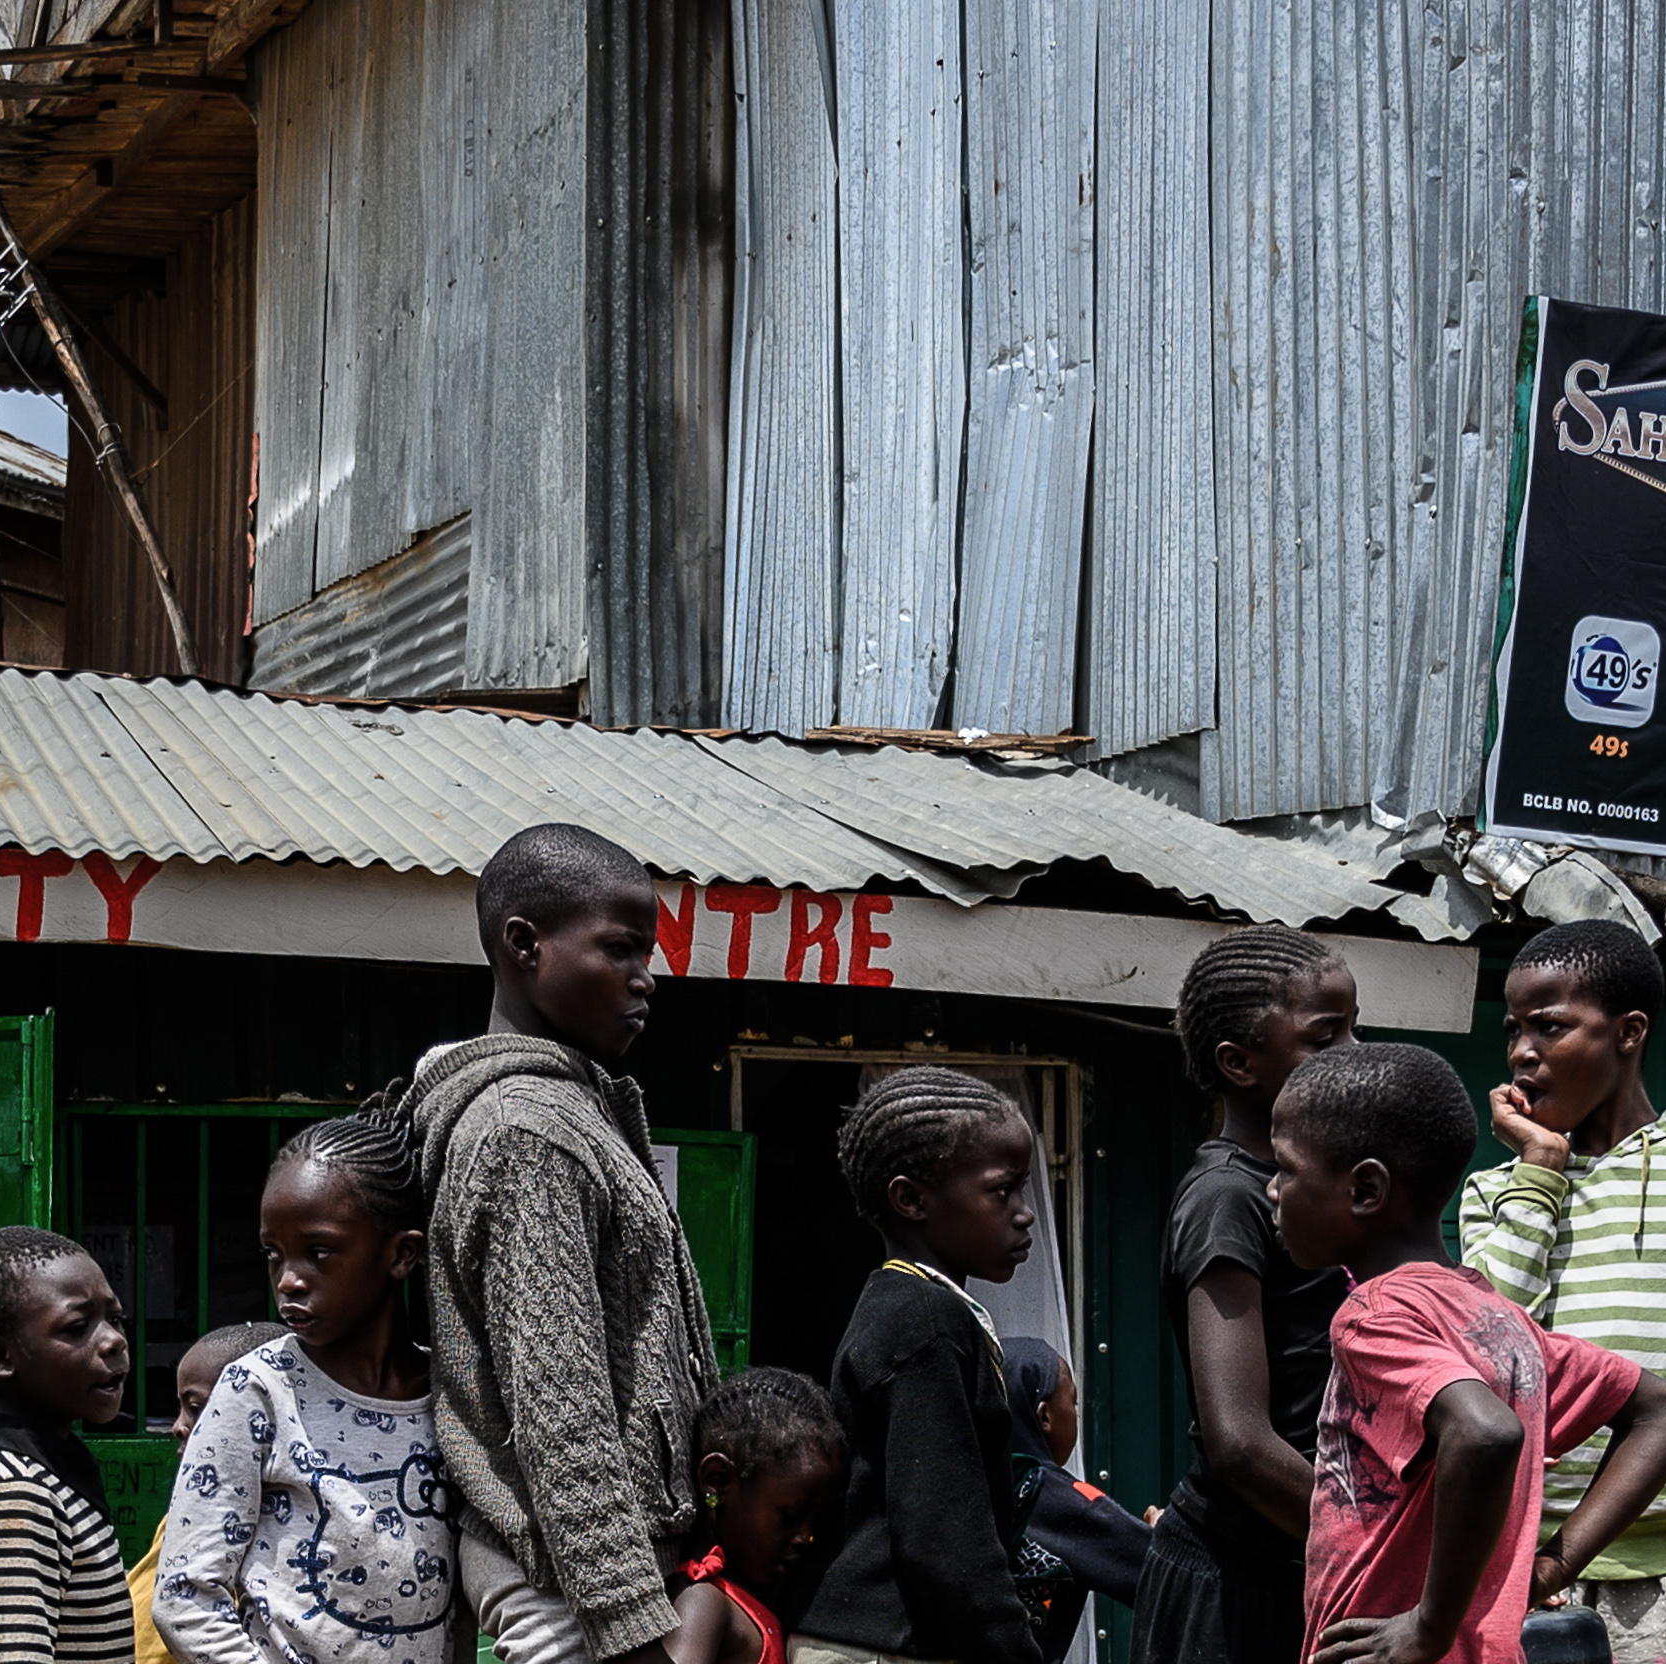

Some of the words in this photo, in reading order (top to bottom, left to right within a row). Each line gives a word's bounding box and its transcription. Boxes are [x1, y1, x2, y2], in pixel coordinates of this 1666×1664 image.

[1589, 734, 1629, 758] 49s
[1523, 792, 1563, 811] BCLB
[1566, 799, 1593, 815] NO.
[1597, 802, 1660, 823] 0000163
[646, 883, 895, 988] NTRE
[96, 1459, 163, 1496] ENT
